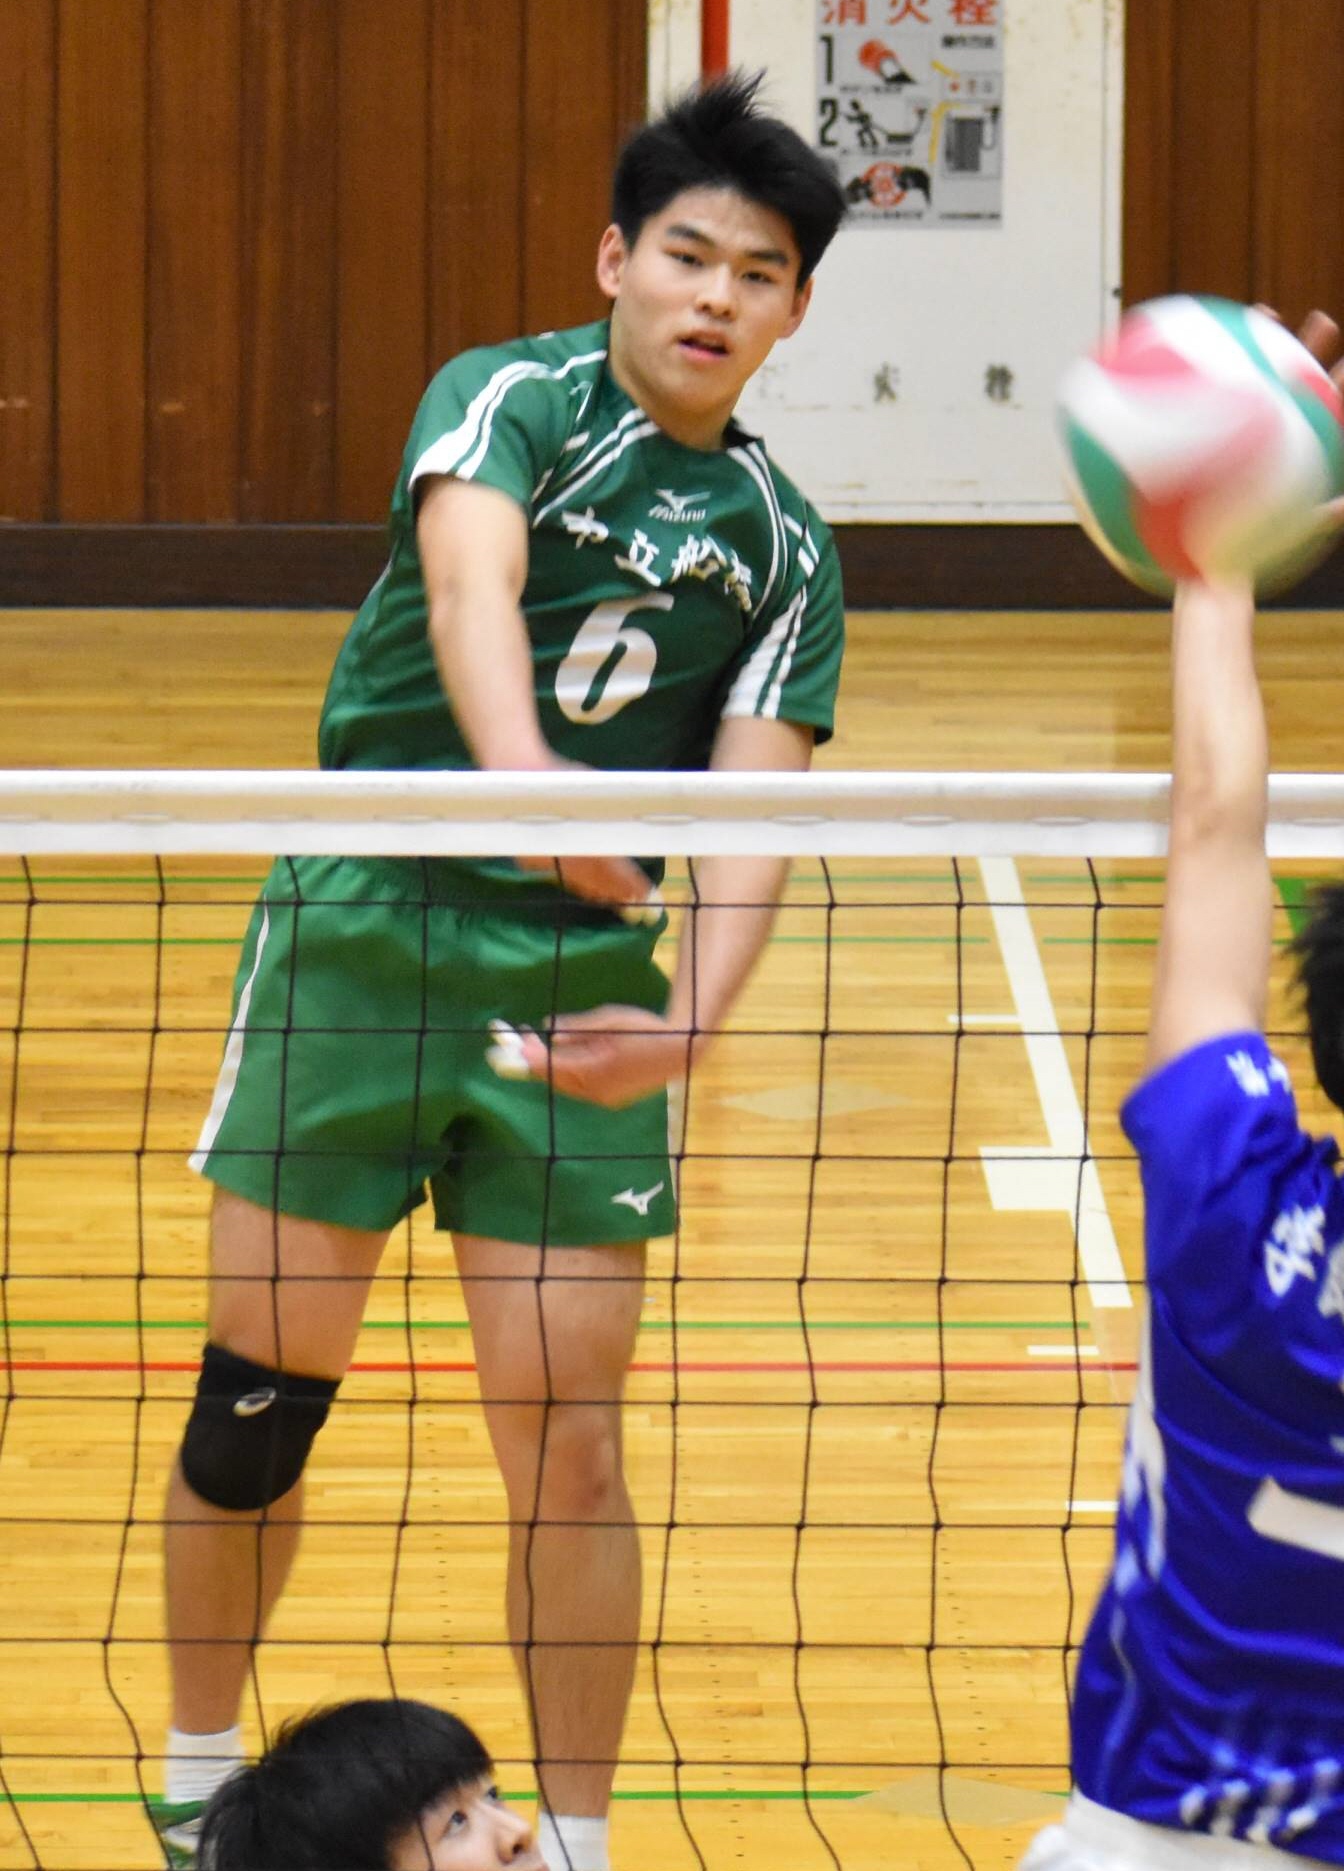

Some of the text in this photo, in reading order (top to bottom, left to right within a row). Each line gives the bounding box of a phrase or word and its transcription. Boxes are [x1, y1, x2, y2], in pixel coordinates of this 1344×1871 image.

[820, 34, 834, 85] 1
[819, 98, 838, 147] 2
[555, 592, 674, 725] 6
